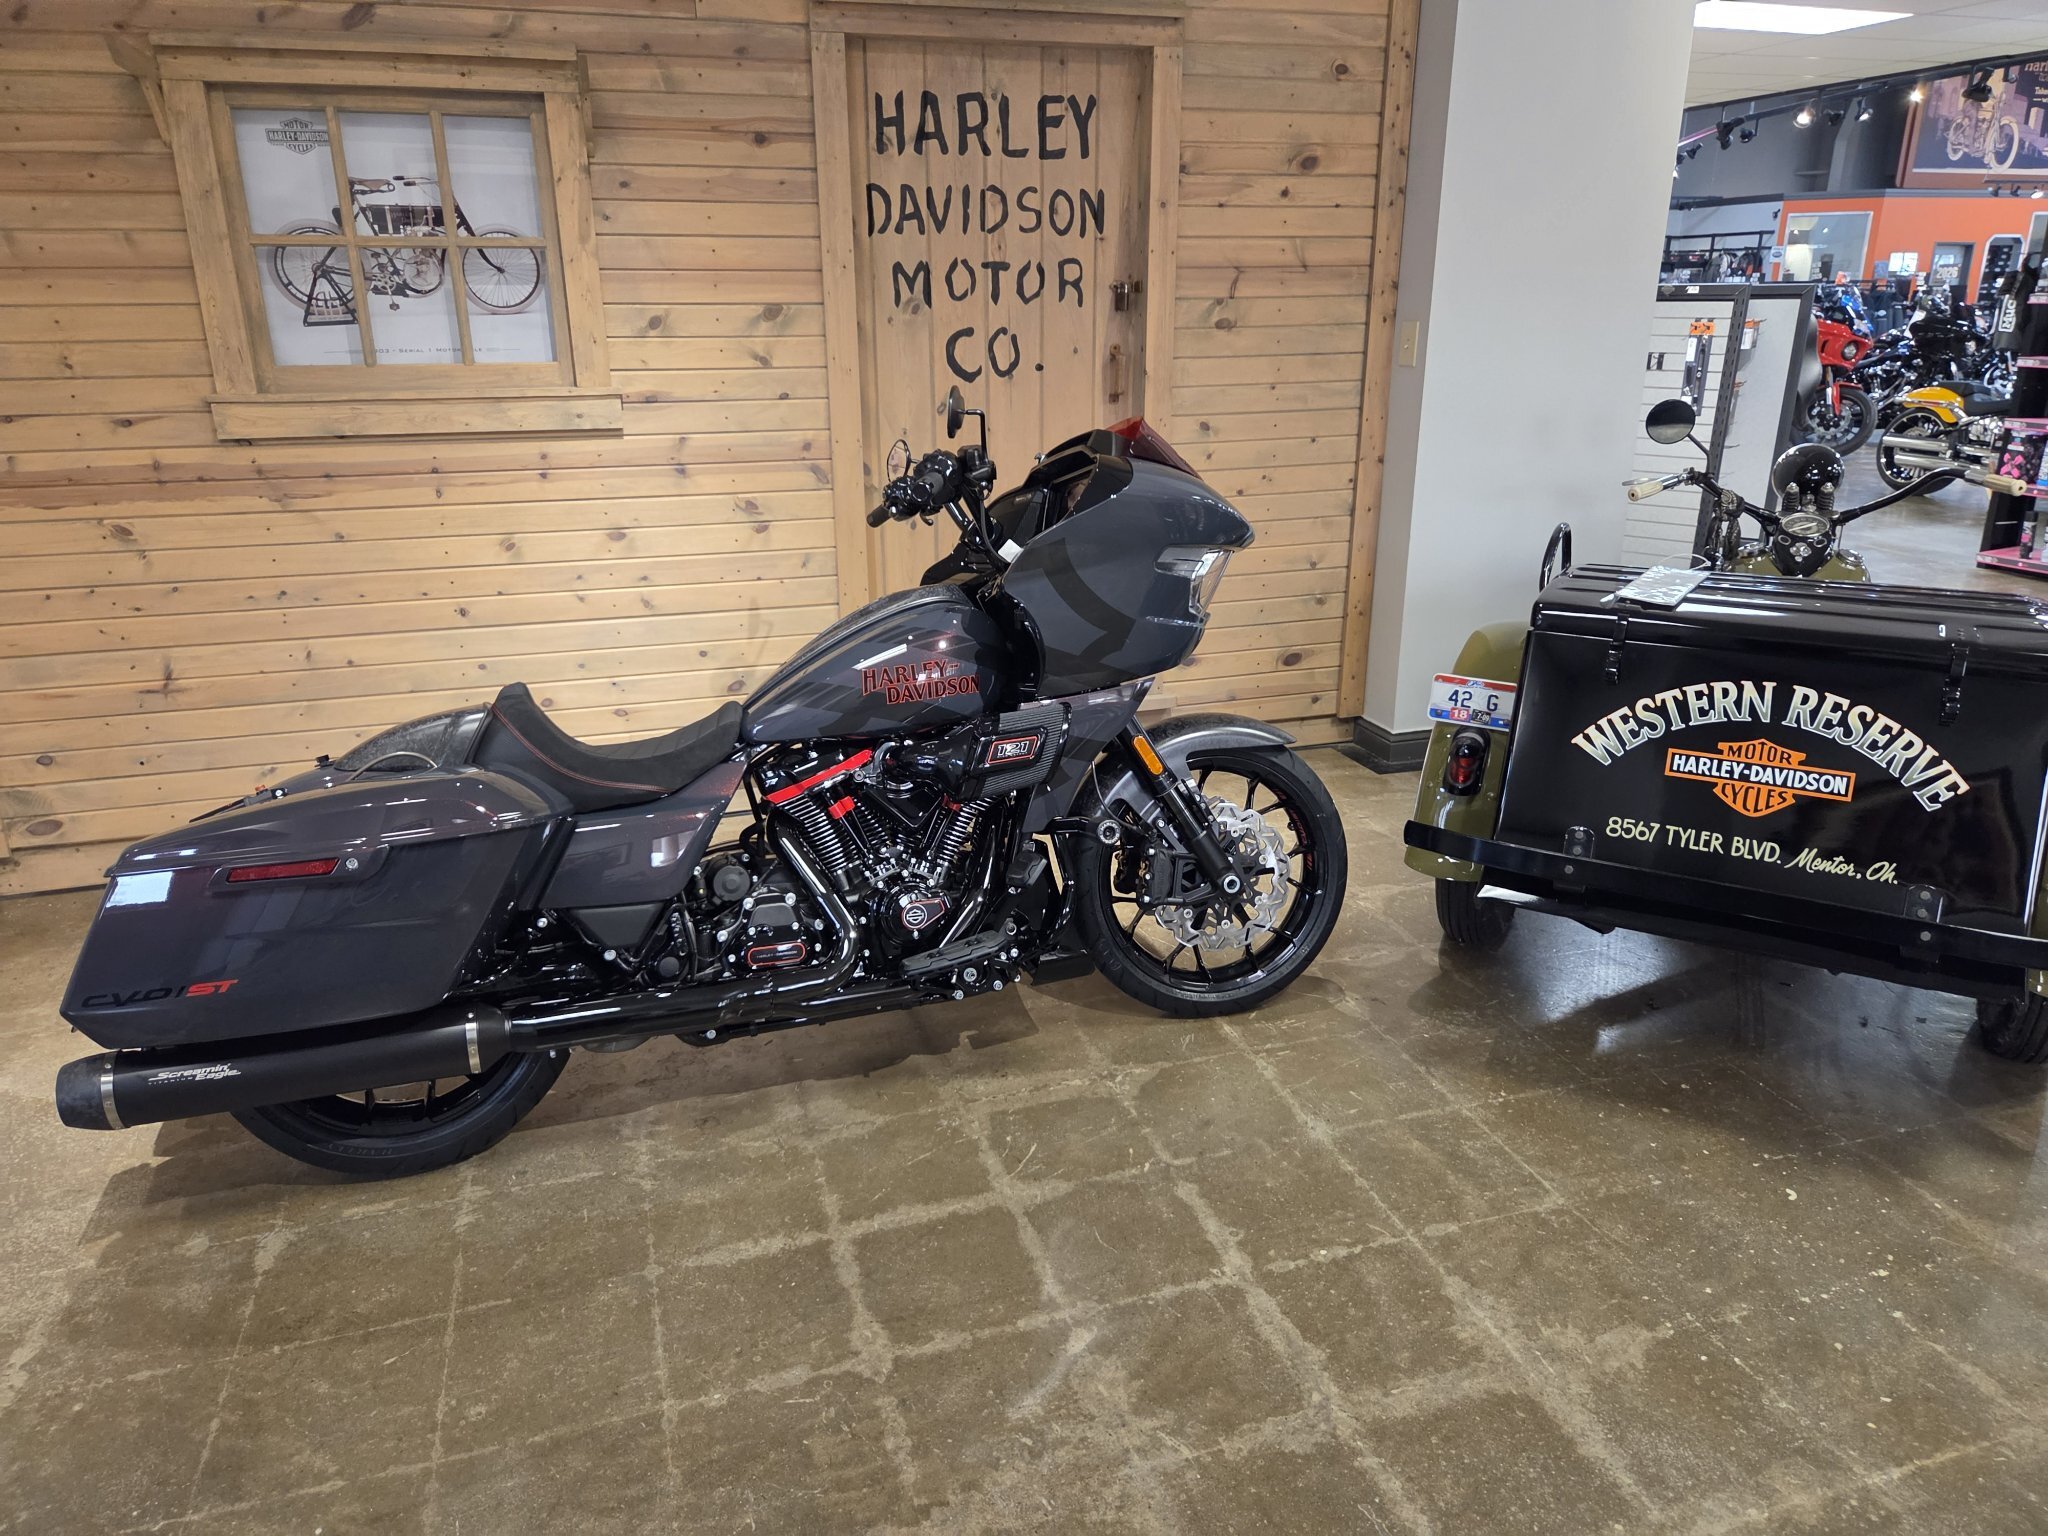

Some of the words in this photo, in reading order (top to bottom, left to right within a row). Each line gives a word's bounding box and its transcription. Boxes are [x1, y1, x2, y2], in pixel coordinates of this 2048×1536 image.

[283, 120, 309, 129] MOTOR
[875, 90, 1097, 160] HARLEY
[288, 143, 313, 152] CYCLES
[866, 183, 1105, 239] DAVIDSON
[892, 257, 1084, 310] MOTOR
[945, 326, 1044, 384] CO.
[886, 675, 979, 705] DAVIDSON
[1448, 689, 1473, 708] 42
[1486, 694, 1499, 712] G
[1452, 709, 1469, 719] 18
[997, 741, 1029, 756] 121
[1571, 680, 1777, 766] WESTERN
[1782, 685, 1970, 812] RESERVE
[1727, 741, 1792, 765] MOTOR
[1672, 754, 1848, 795] HARLEY-DAVIDSON
[1720, 782, 1788, 814] CYCLES
[1605, 816, 1660, 842] 8567
[1665, 825, 1724, 854] TYLER
[1731, 836, 1782, 864] BLVD.
[1784, 848, 1861, 880] Mentor,
[1865, 861, 1898, 885] Oh.
[148, 1063, 231, 1081] Screamin'
[195, 1069, 241, 1081] Eagle
